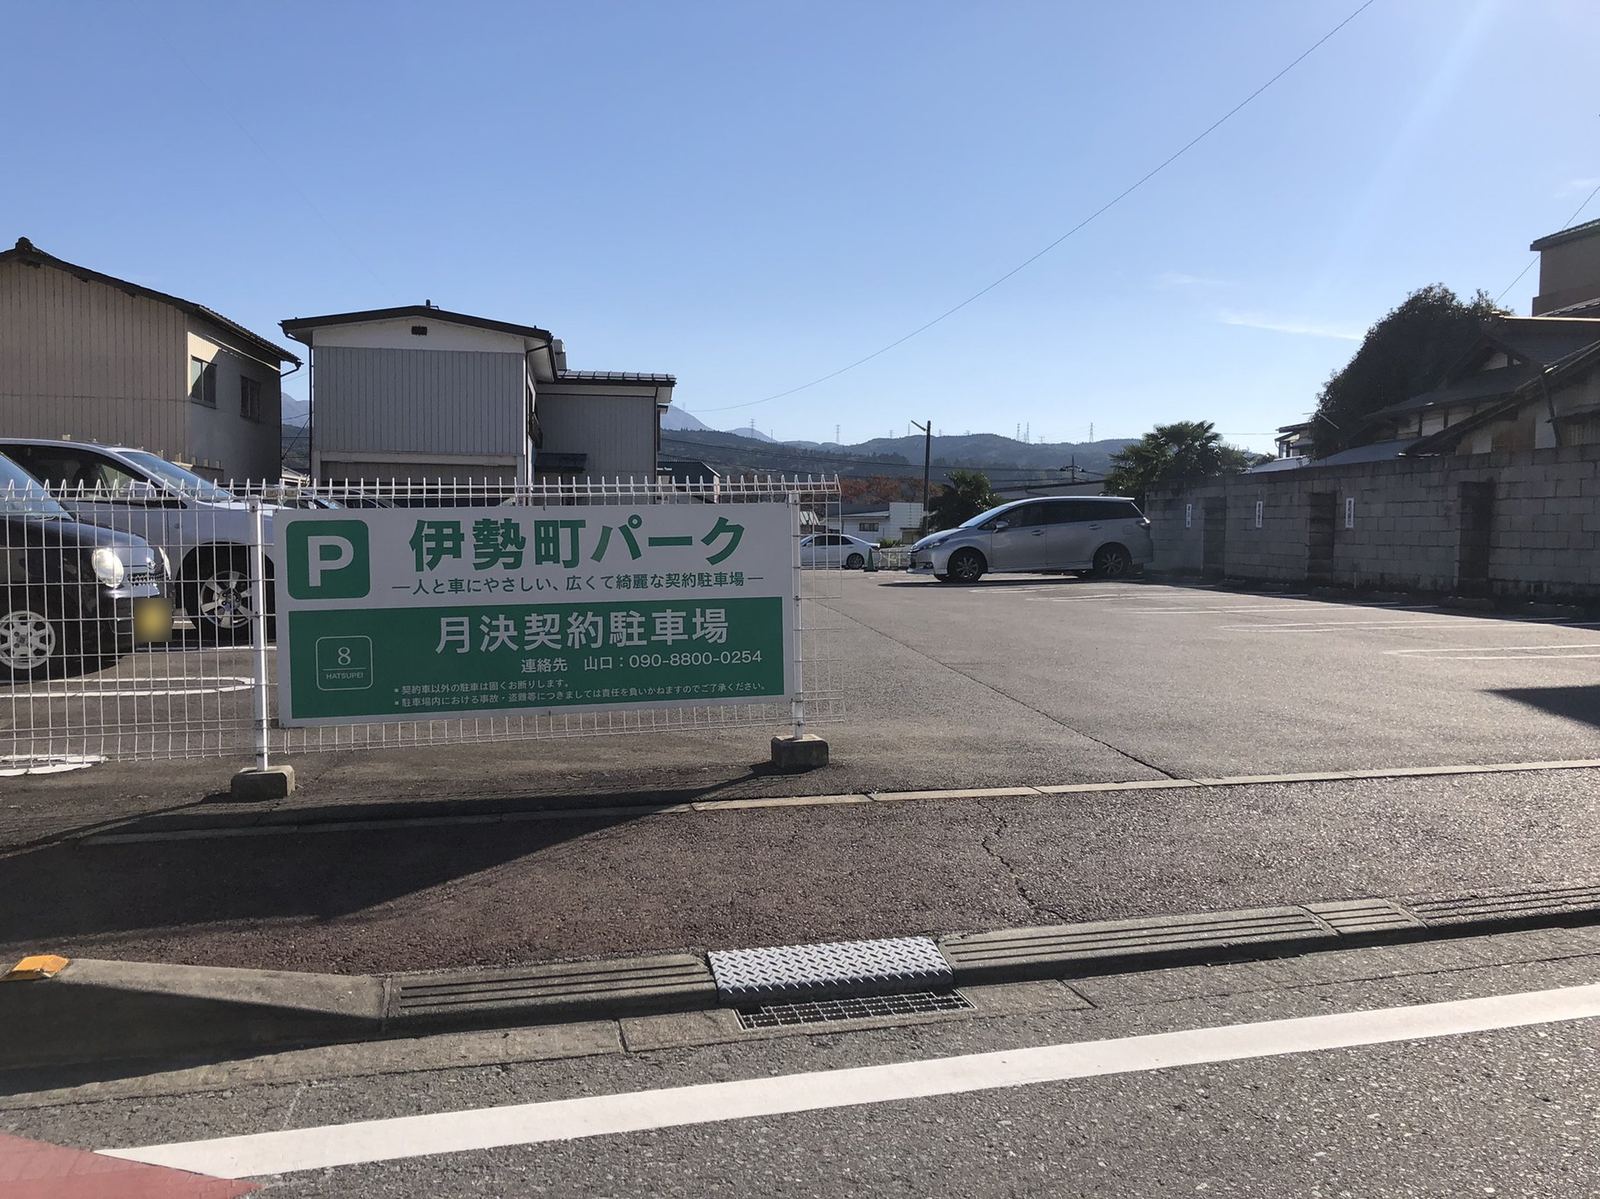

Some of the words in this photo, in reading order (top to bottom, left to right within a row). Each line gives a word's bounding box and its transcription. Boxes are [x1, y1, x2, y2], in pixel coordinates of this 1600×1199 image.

[308, 535, 355, 588] P
[408, 513, 745, 573] 伊勢町パーク
[434, 607, 729, 655] 月決契約駐車場
[337, 646, 352, 666] 8
[520, 657, 568, 674] 連絡先
